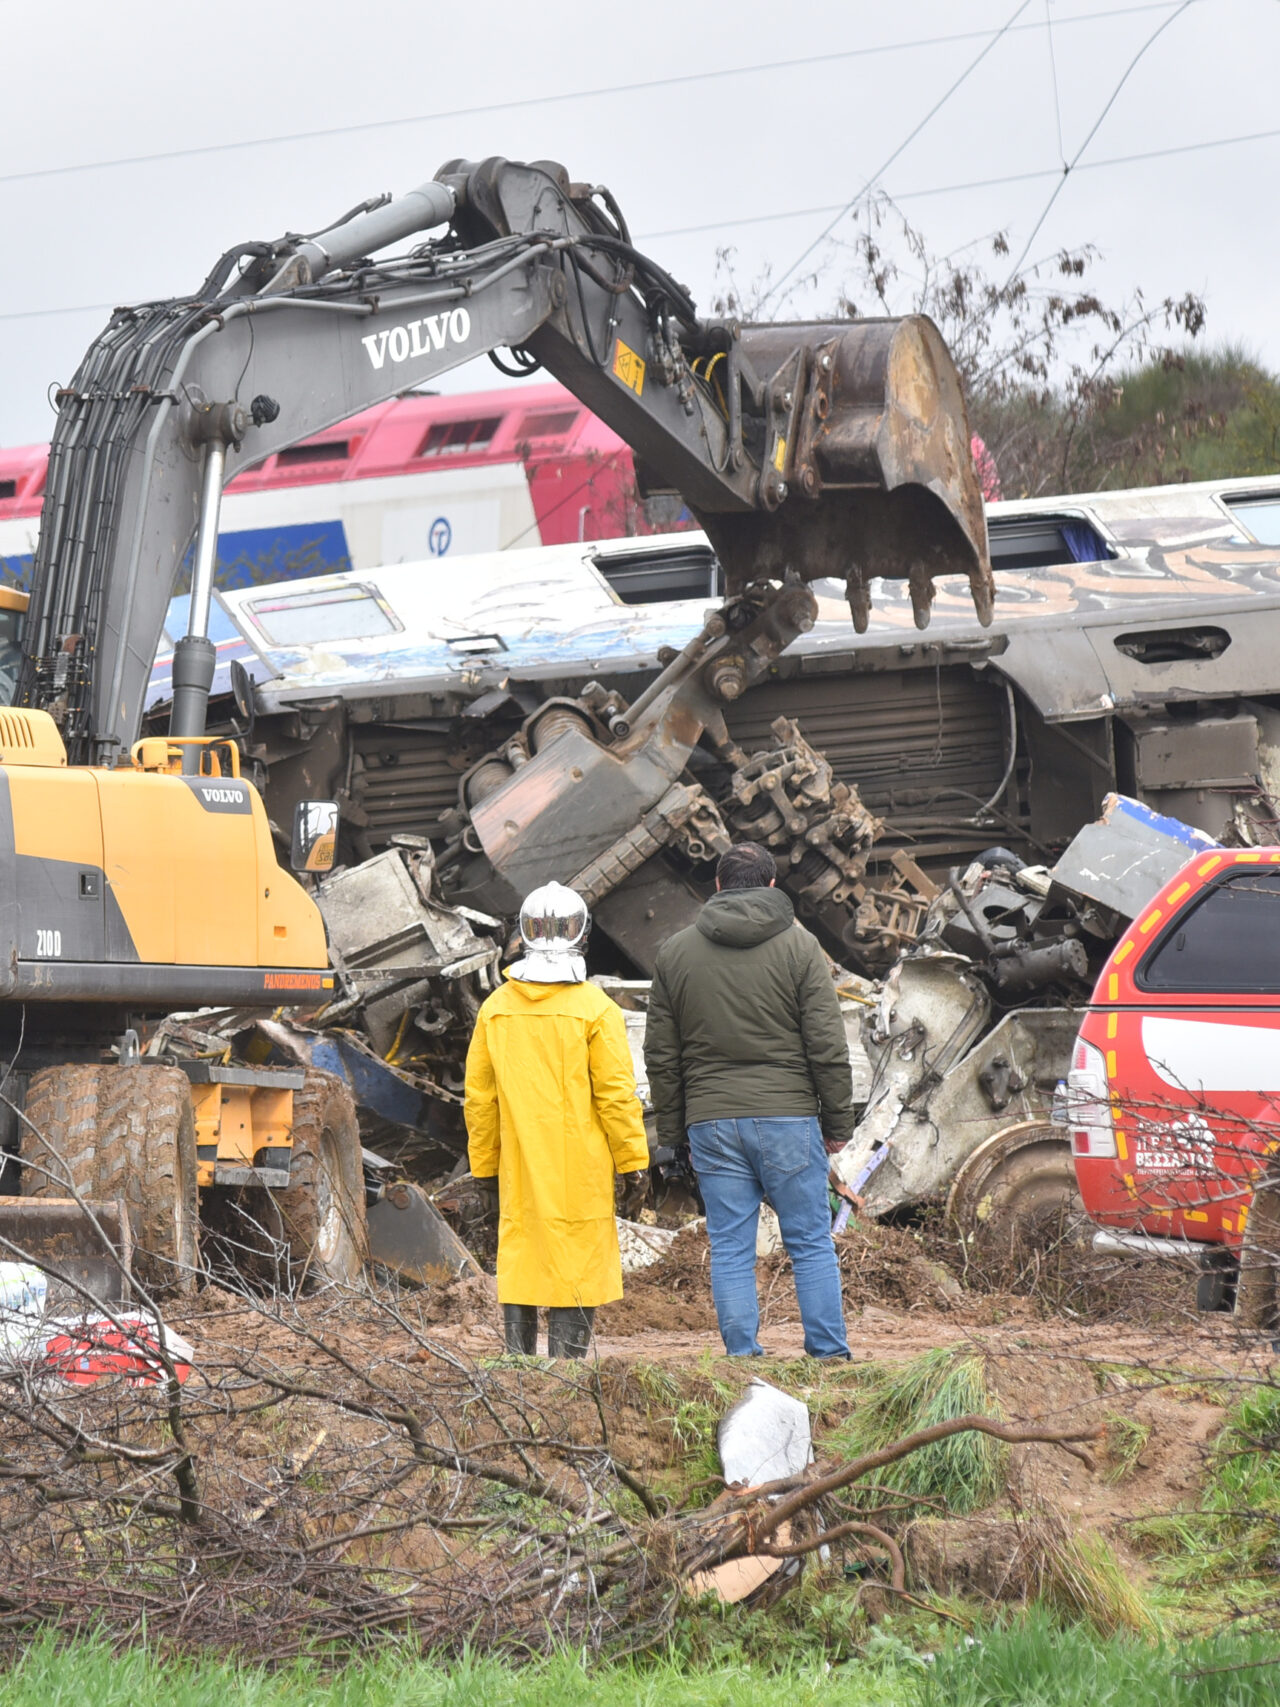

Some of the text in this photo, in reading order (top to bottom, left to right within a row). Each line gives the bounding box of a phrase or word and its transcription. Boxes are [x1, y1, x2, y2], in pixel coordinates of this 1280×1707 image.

[361, 307, 471, 370] VOLVO
[201, 788, 244, 803] VOLVO
[264, 973, 321, 990] PANDREMENOS
